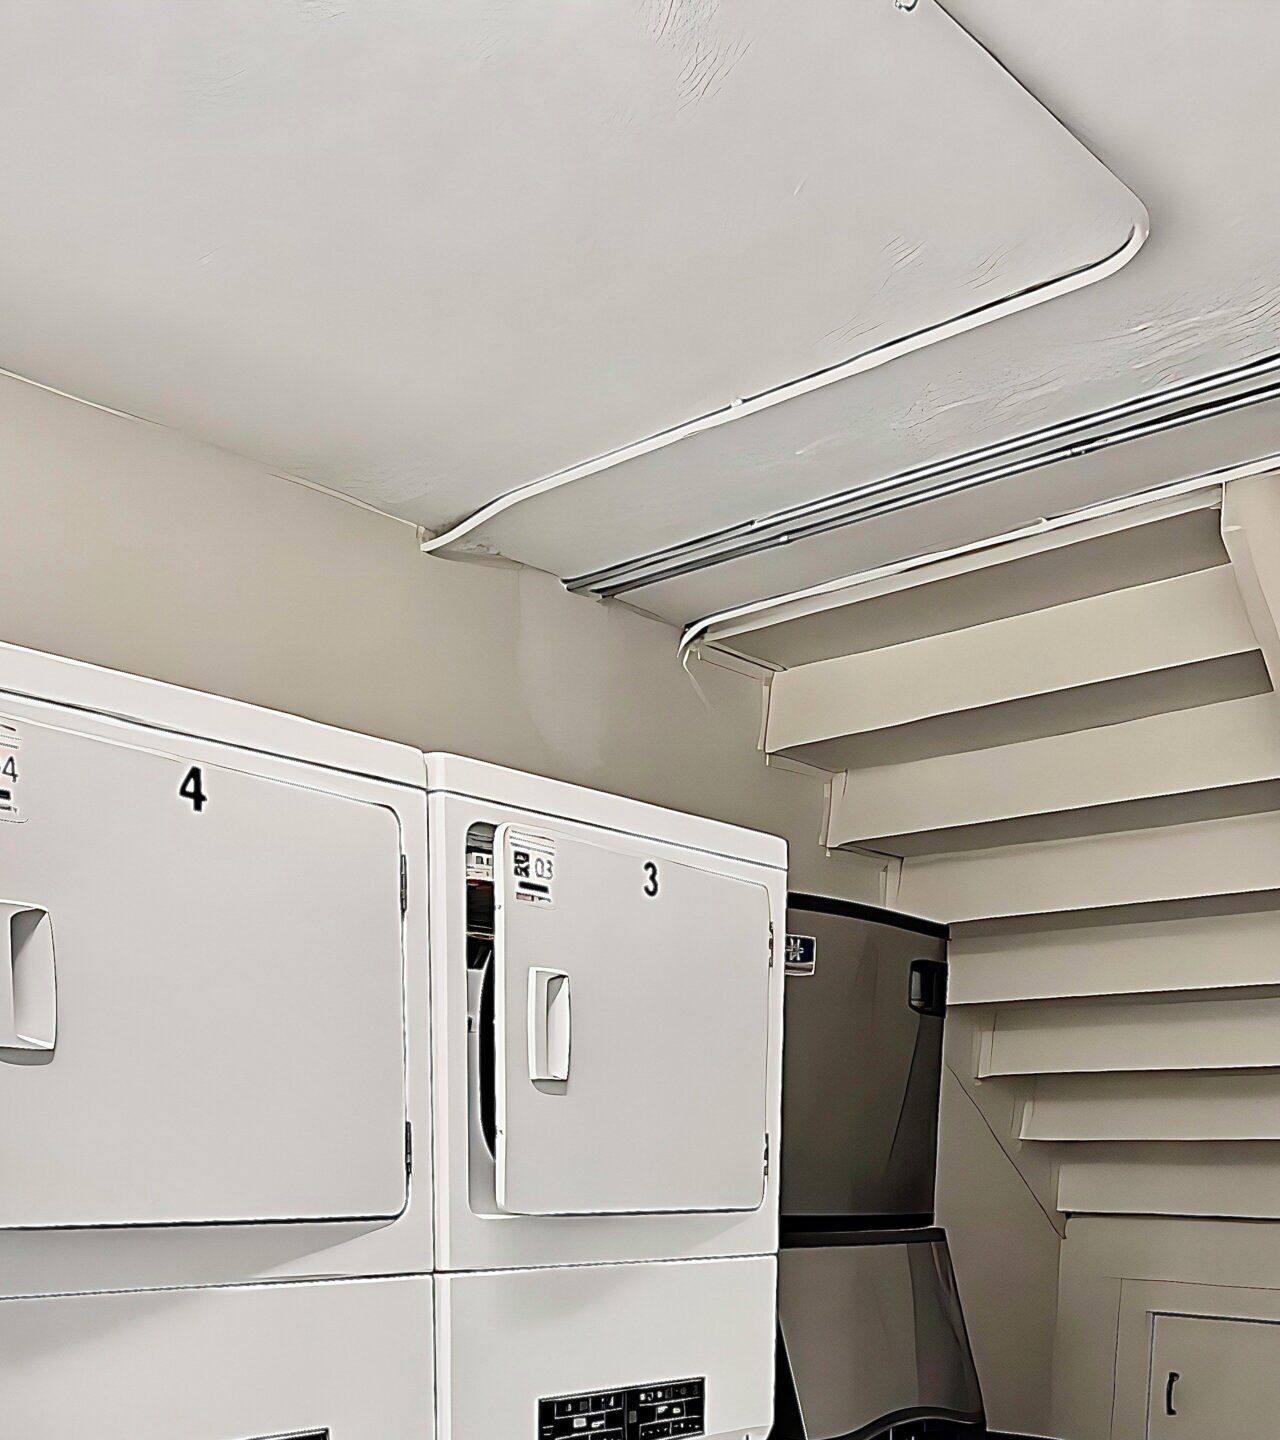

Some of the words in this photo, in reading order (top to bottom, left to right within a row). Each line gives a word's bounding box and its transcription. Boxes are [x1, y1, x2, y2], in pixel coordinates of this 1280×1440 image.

[178, 766, 208, 812] 4
[534, 857, 554, 880] 03
[642, 861, 659, 897] 3
